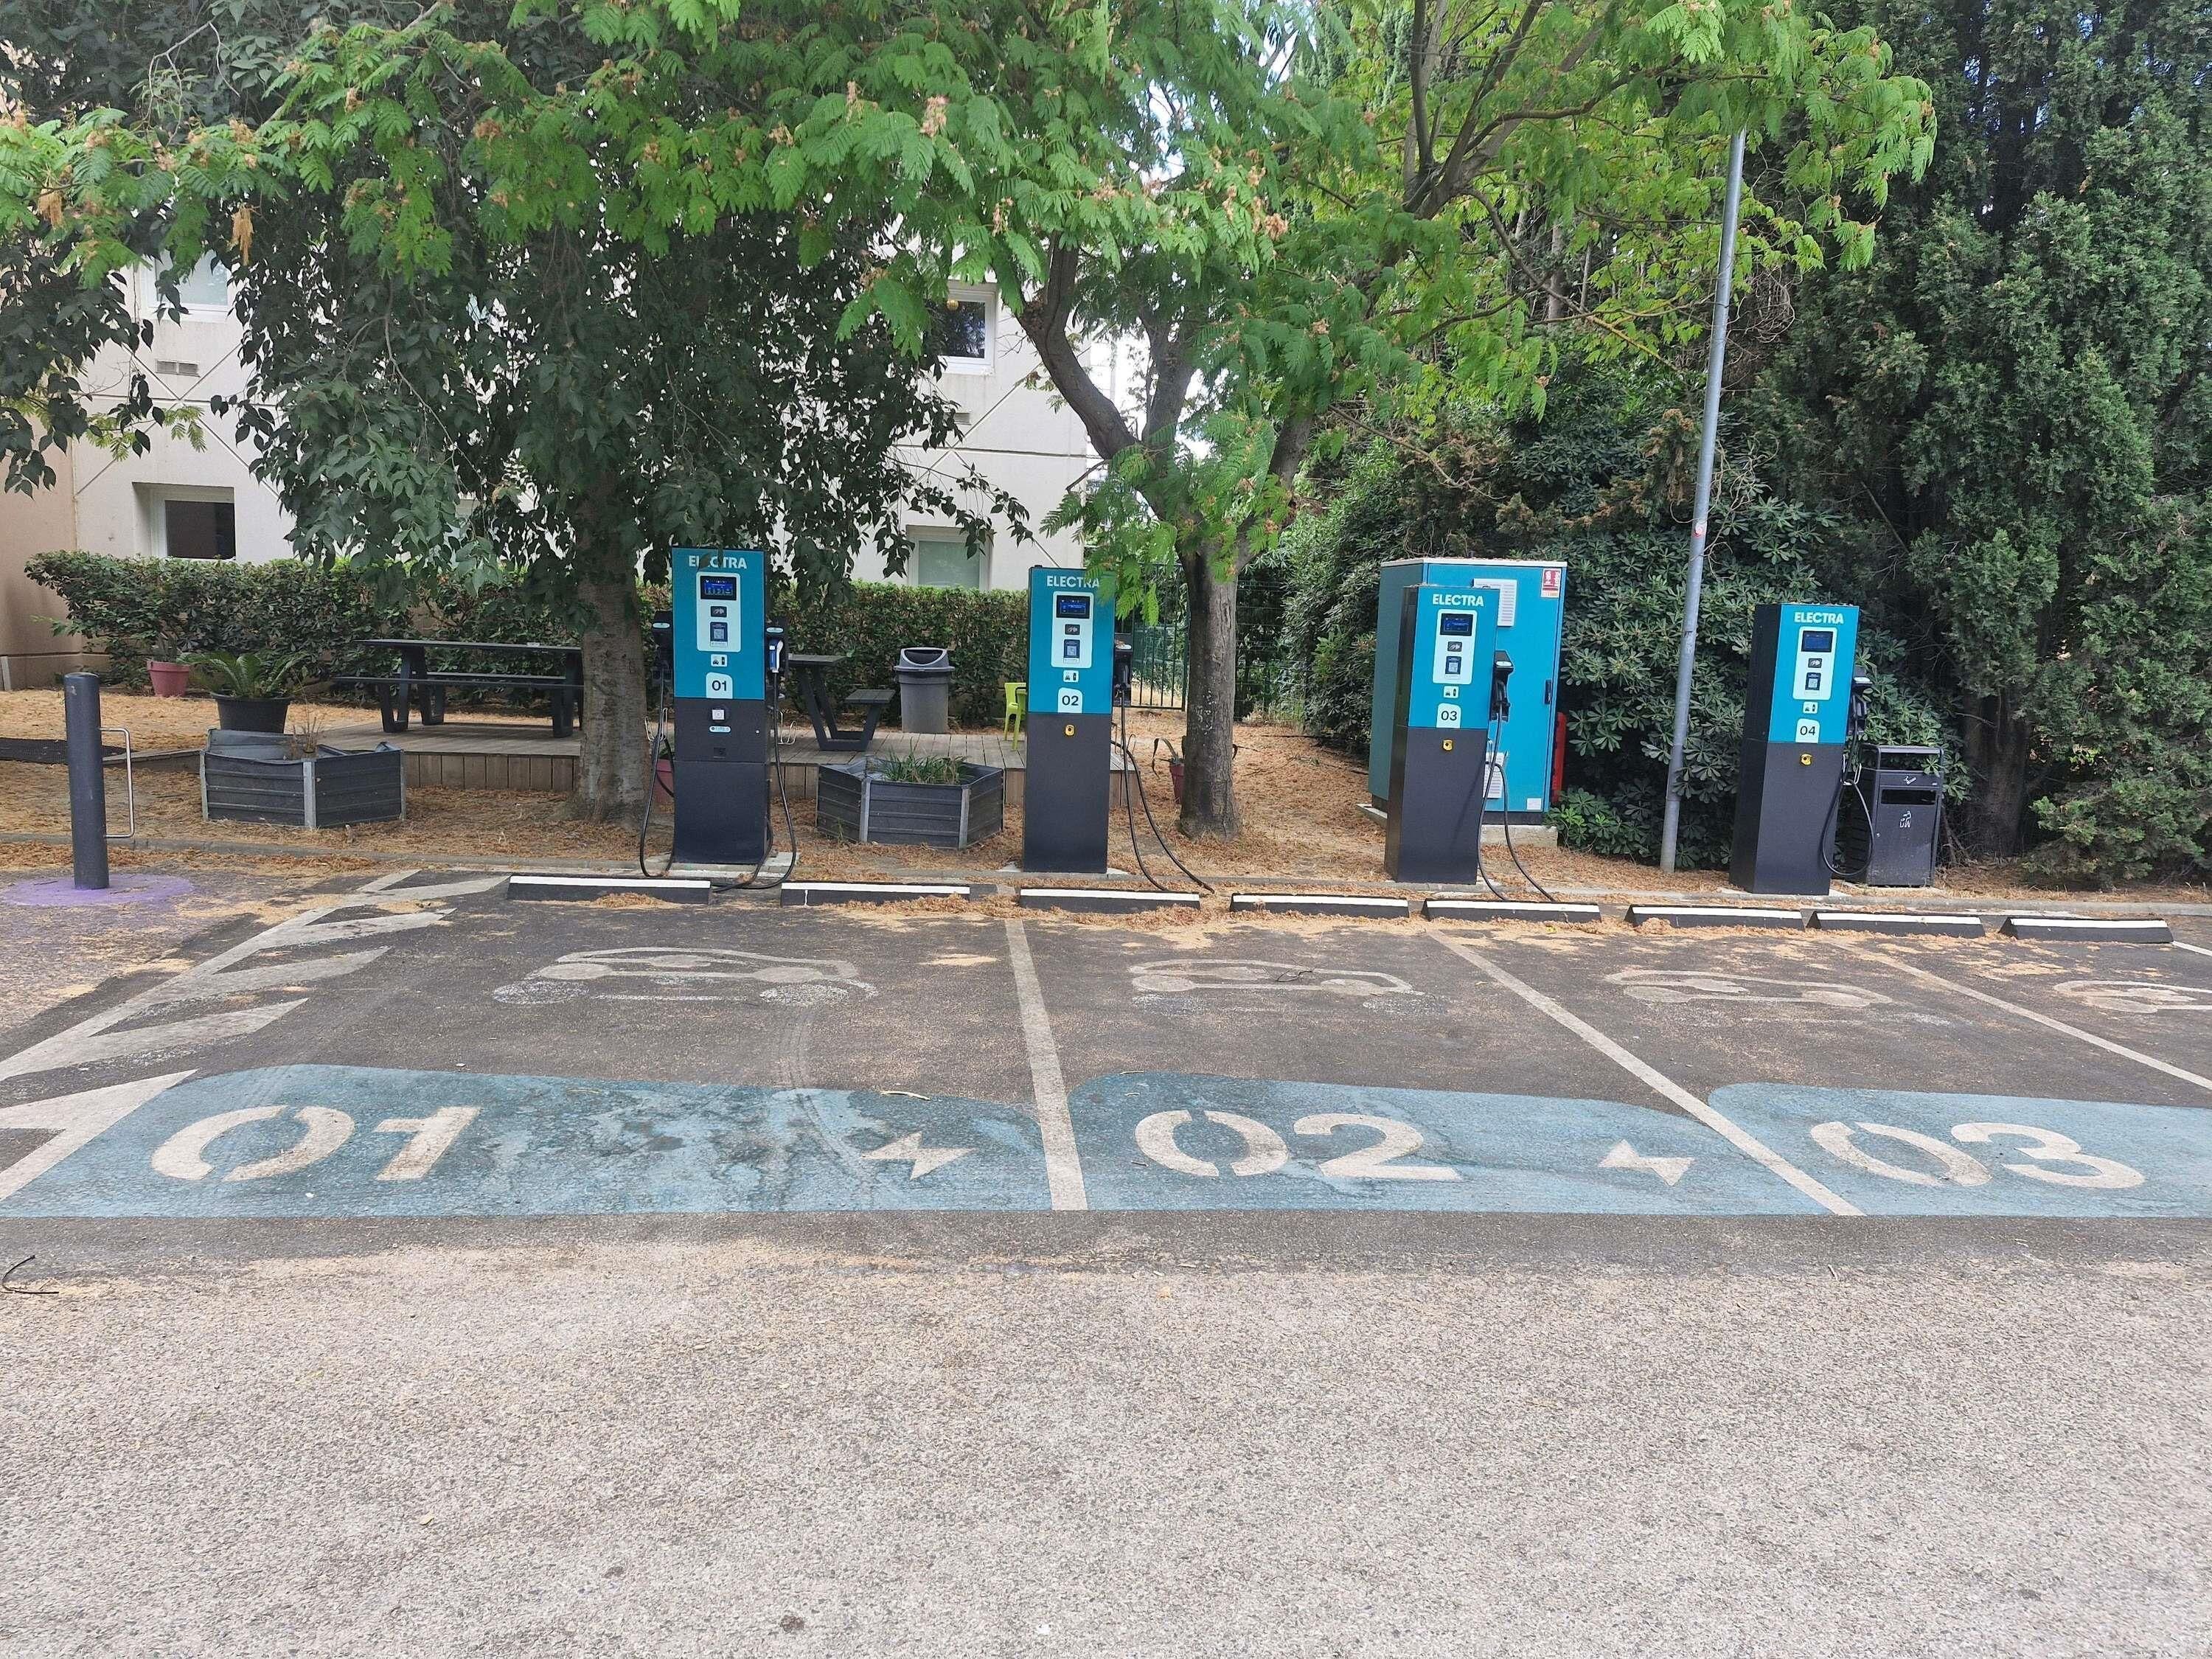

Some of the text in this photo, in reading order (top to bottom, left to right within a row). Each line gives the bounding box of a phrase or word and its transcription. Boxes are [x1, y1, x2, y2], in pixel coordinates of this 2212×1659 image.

[1432, 594, 1484, 607] ELECTRA
[1794, 611, 1844, 625] ELECTRA
[712, 680, 727, 692] 01
[1062, 695, 1079, 706] 02
[1441, 710, 1458, 721] 03
[1800, 726, 1816, 736] 04
[150, 1105, 482, 1181] 01
[1134, 1109, 1463, 1181] 02
[1809, 1121, 2147, 1189] 03
